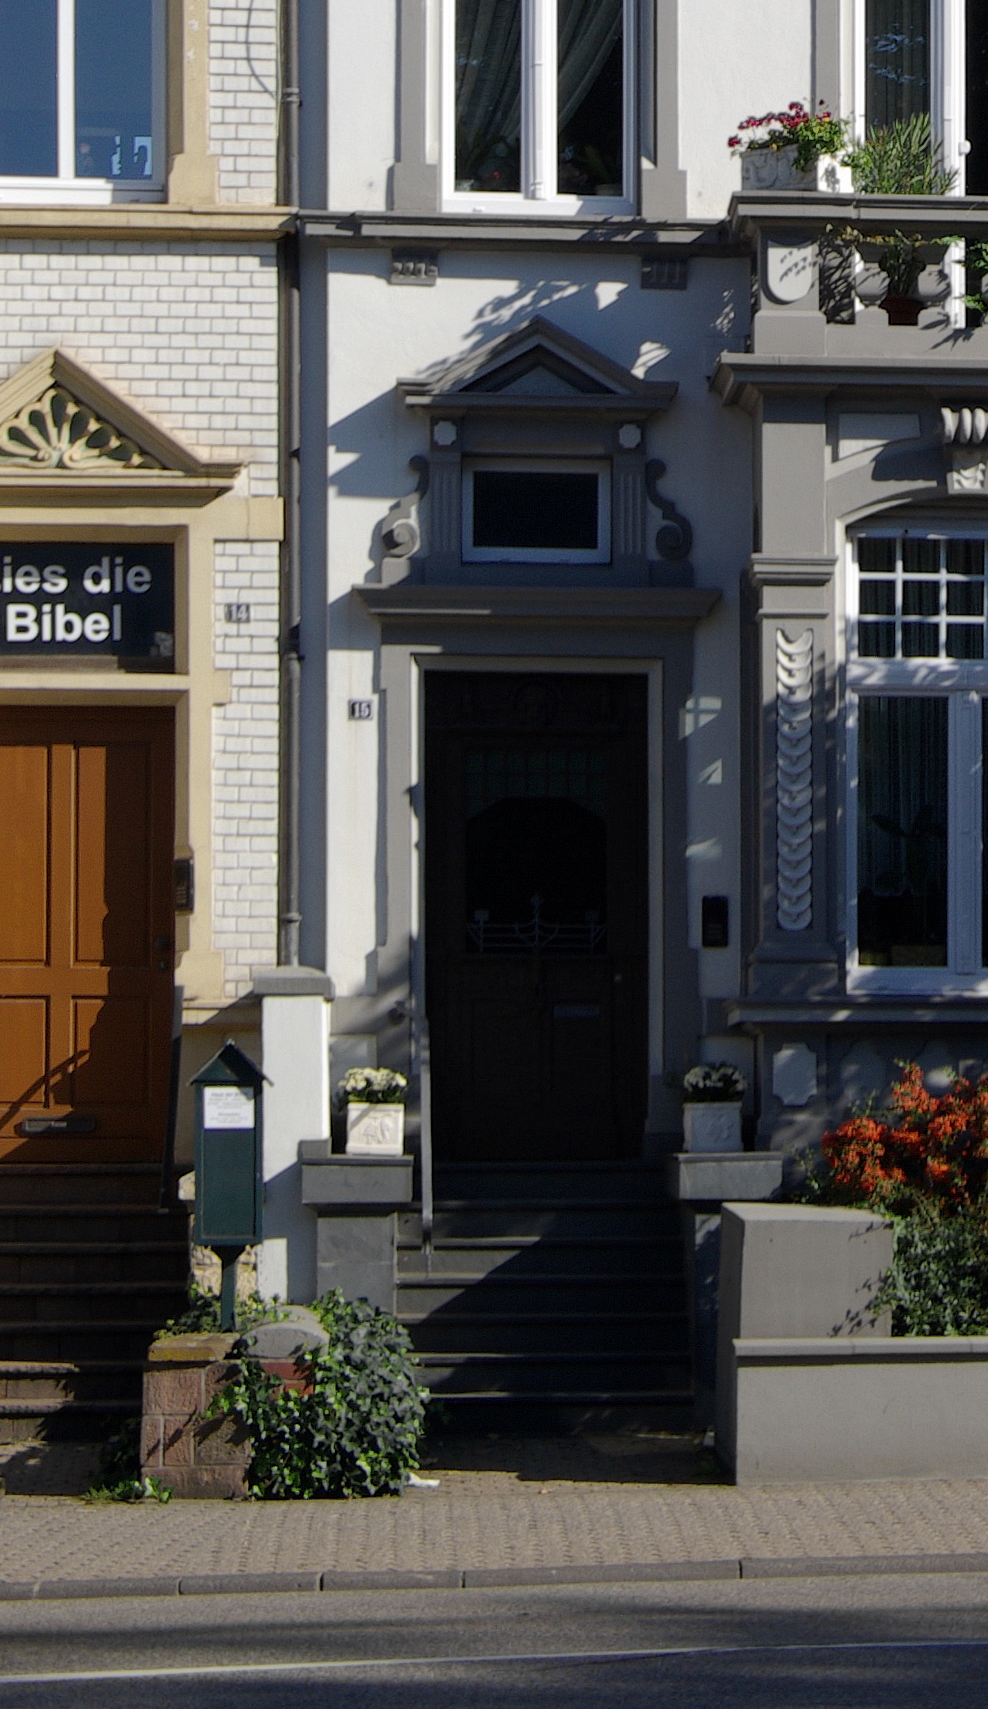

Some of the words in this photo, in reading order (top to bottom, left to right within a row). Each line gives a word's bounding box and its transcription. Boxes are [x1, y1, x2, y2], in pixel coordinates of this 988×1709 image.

[0, 555, 68, 594] ies
[83, 556, 151, 594] die
[6, 603, 122, 642] Bibel
[230, 604, 249, 621] 14
